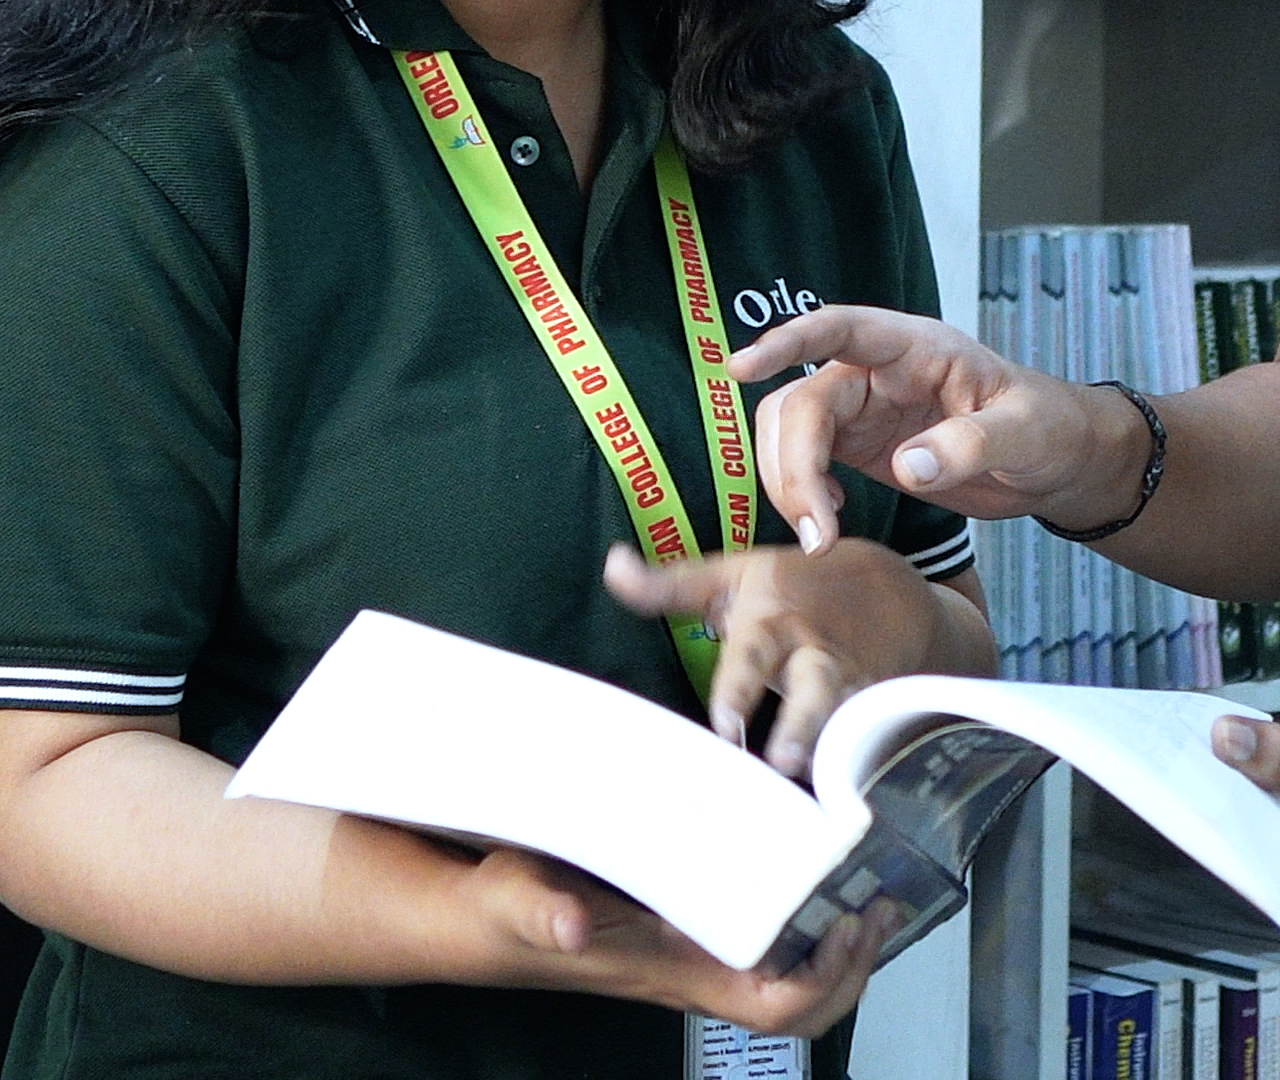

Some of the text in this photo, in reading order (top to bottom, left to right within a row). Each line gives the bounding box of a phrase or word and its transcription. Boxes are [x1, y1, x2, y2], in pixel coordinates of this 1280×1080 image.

[405, 50, 461, 120] ORLEA
[665, 198, 715, 328] PHARMACY
[732, 277, 825, 329] Orle
[495, 230, 666, 510] COLLEGE OF PHARMACY
[699, 335, 724, 365] OF
[708, 378, 746, 478] COLLEGE
